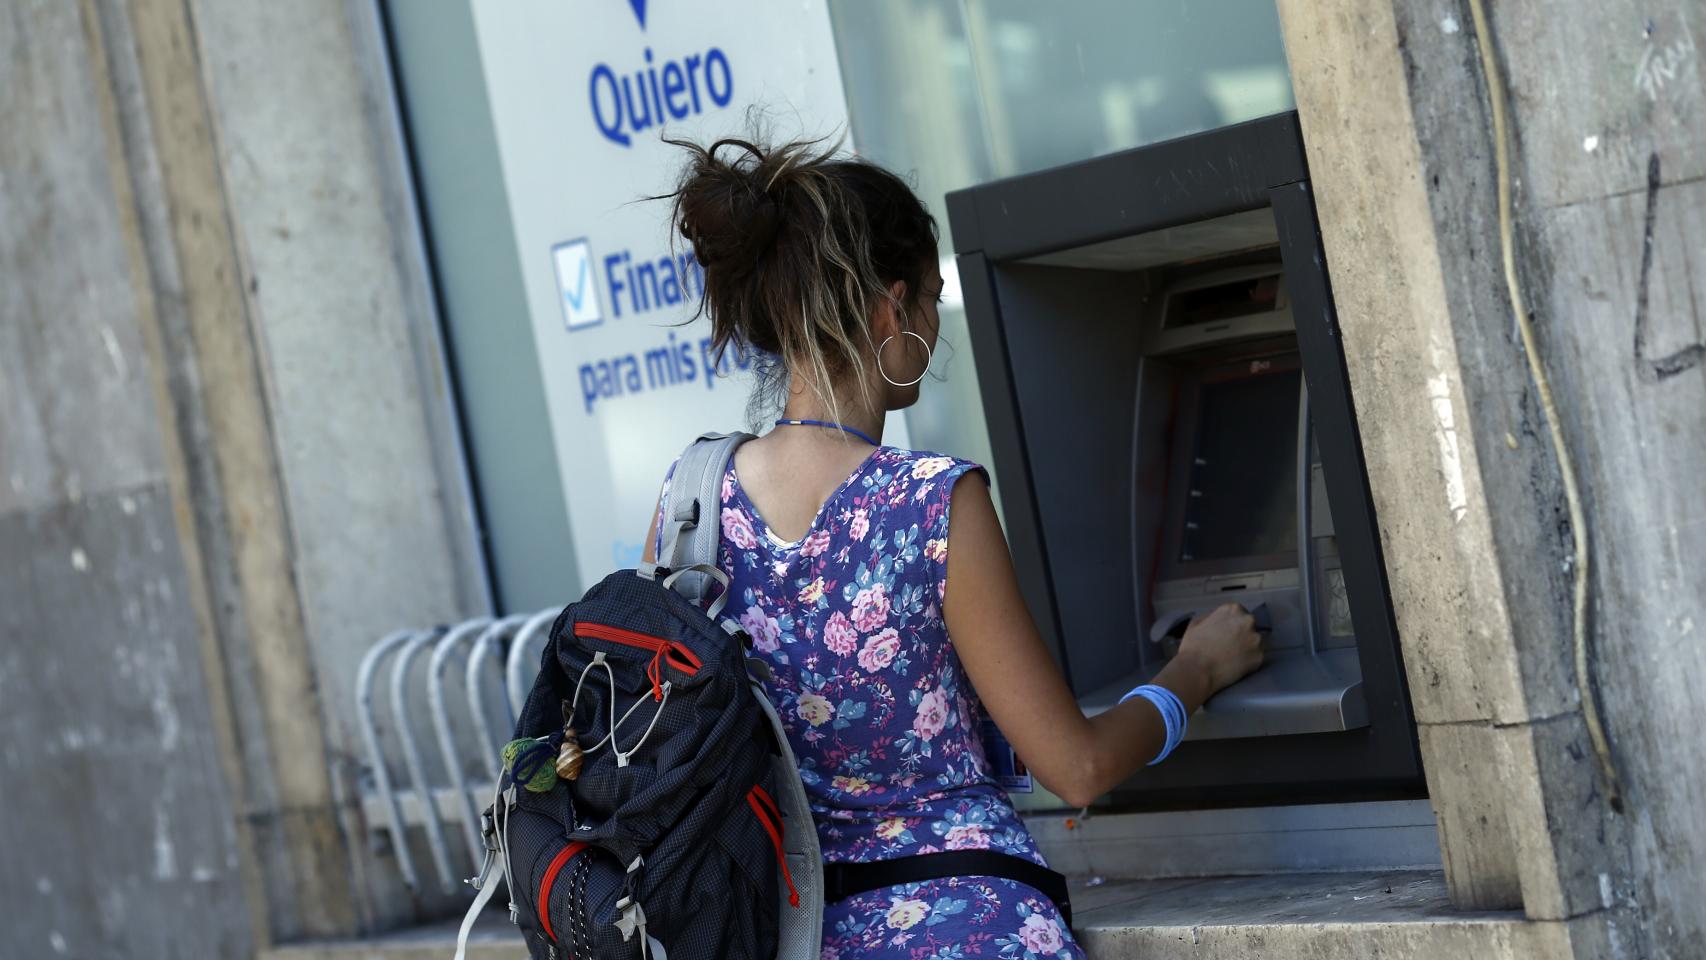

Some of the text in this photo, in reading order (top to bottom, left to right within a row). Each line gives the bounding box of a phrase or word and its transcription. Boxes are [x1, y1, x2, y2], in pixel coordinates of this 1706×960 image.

[588, 47, 734, 147] Quiero
[603, 250, 708, 319] Finan
[578, 331, 758, 416] para mis pro
